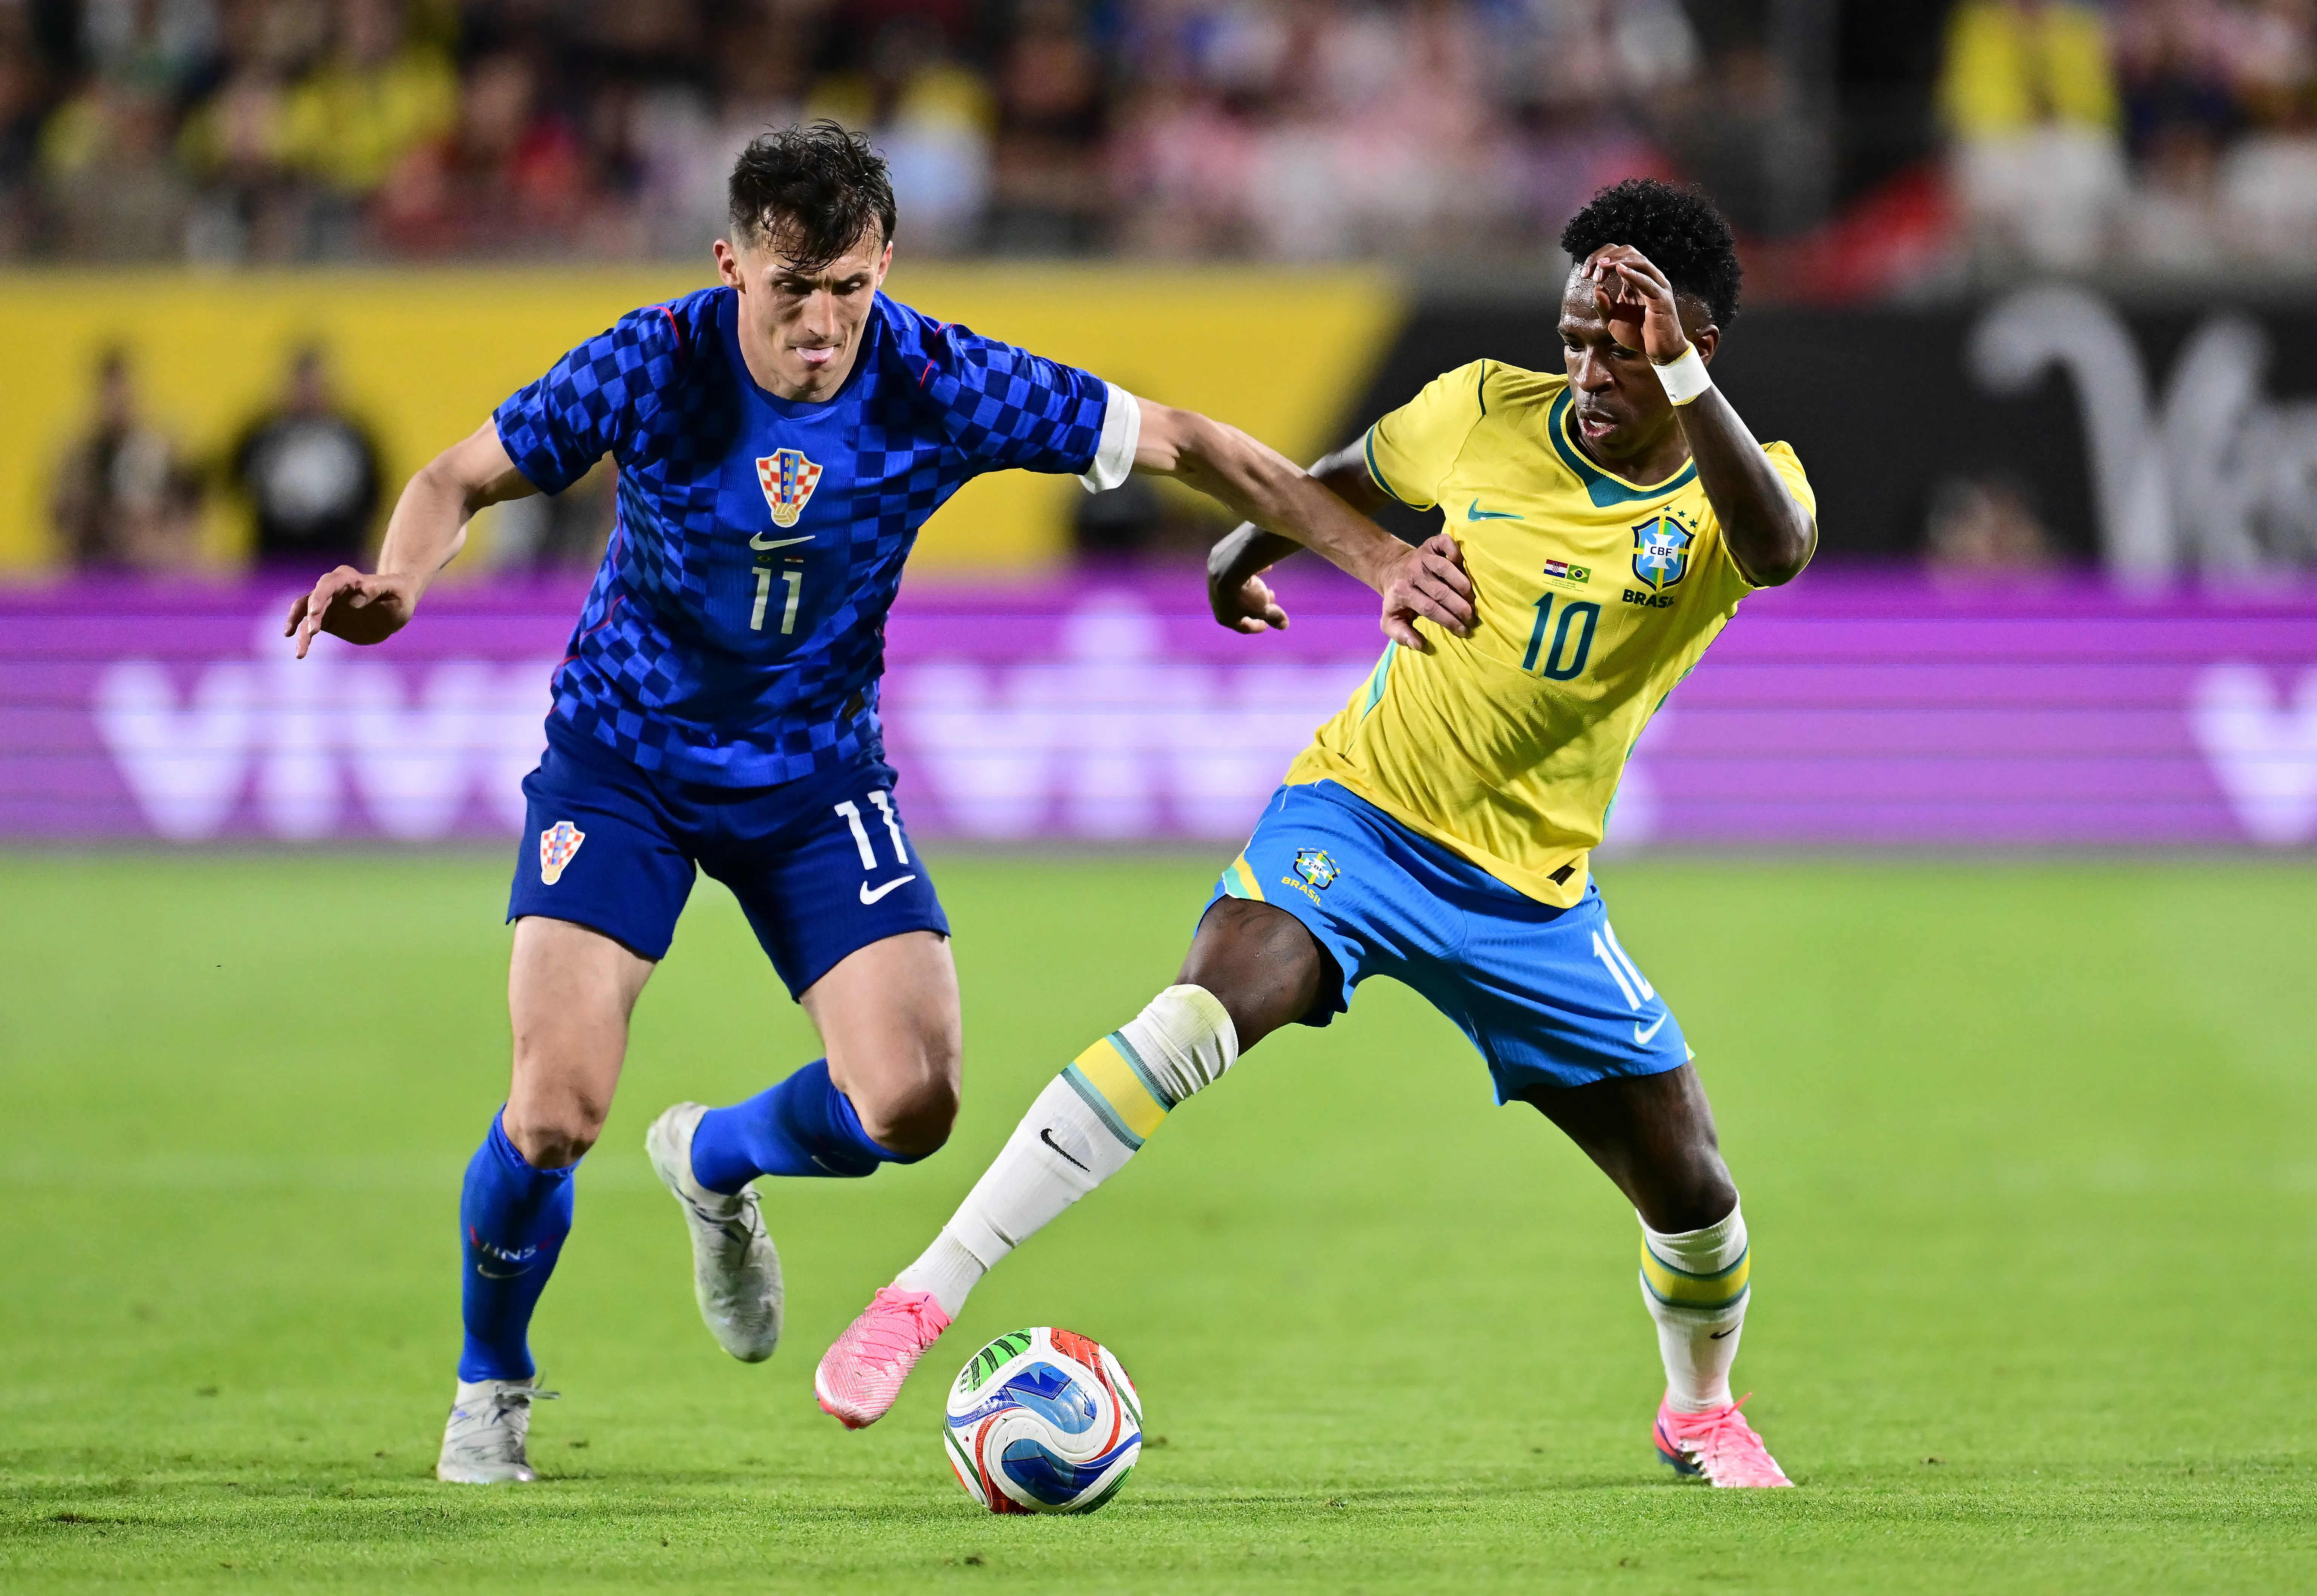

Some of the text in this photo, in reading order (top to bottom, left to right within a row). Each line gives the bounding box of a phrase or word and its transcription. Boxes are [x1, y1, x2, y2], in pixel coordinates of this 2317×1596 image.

[1650, 546, 1672, 556] CBF
[750, 567, 802, 635] 11
[1521, 592, 1601, 681] 10
[834, 790, 909, 870] 11
[1281, 876, 1321, 907] BRASIL
[1308, 862, 1324, 872] CBF
